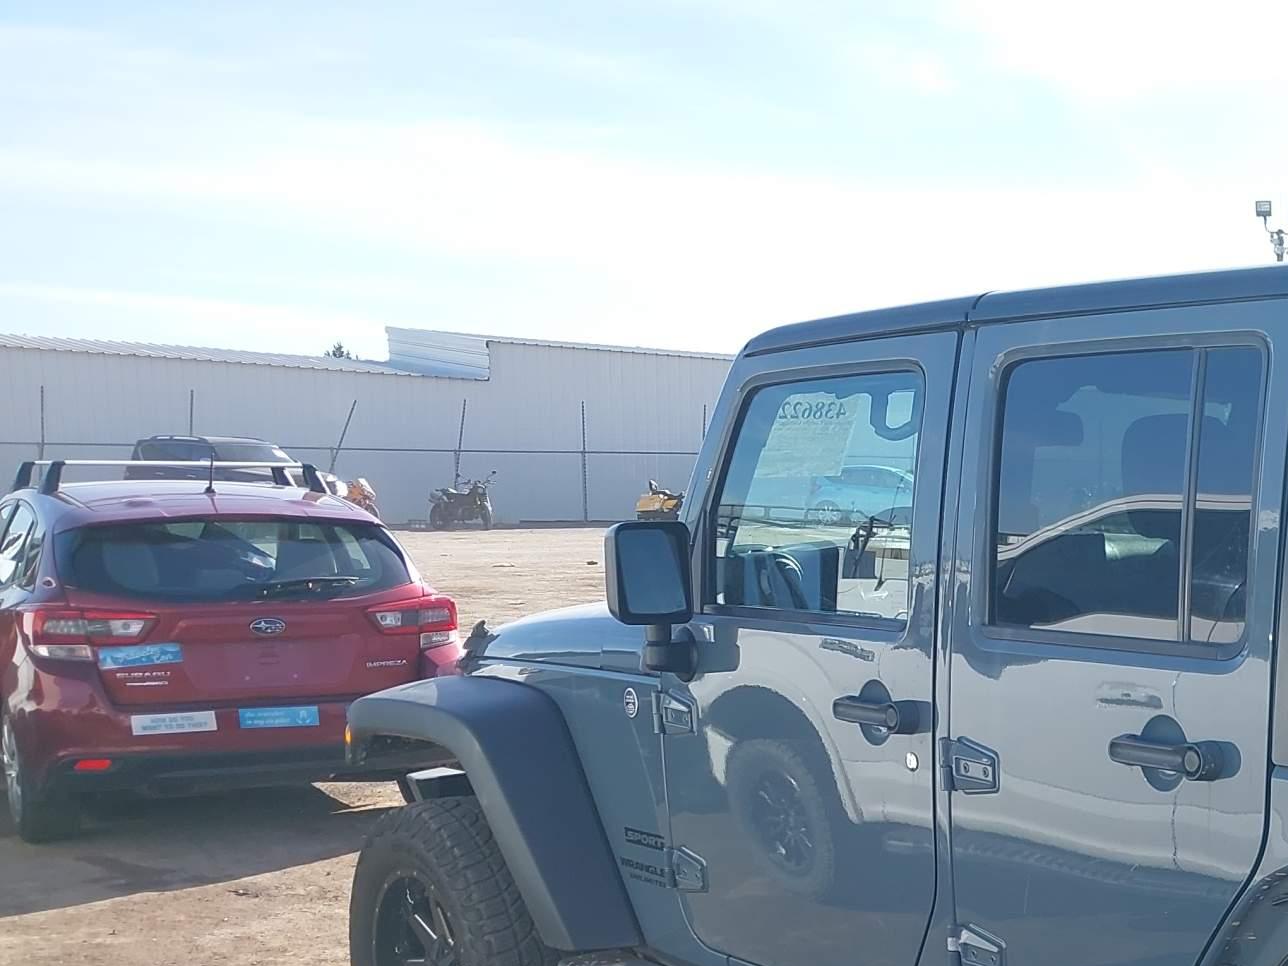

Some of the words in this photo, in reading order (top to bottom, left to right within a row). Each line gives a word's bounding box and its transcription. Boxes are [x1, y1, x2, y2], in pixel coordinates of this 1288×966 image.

[366, 659, 408, 668] IMPREZA
[115, 671, 171, 679] SUBARU
[625, 830, 665, 850] SPORT
[620, 857, 665, 878] WRANGLE
